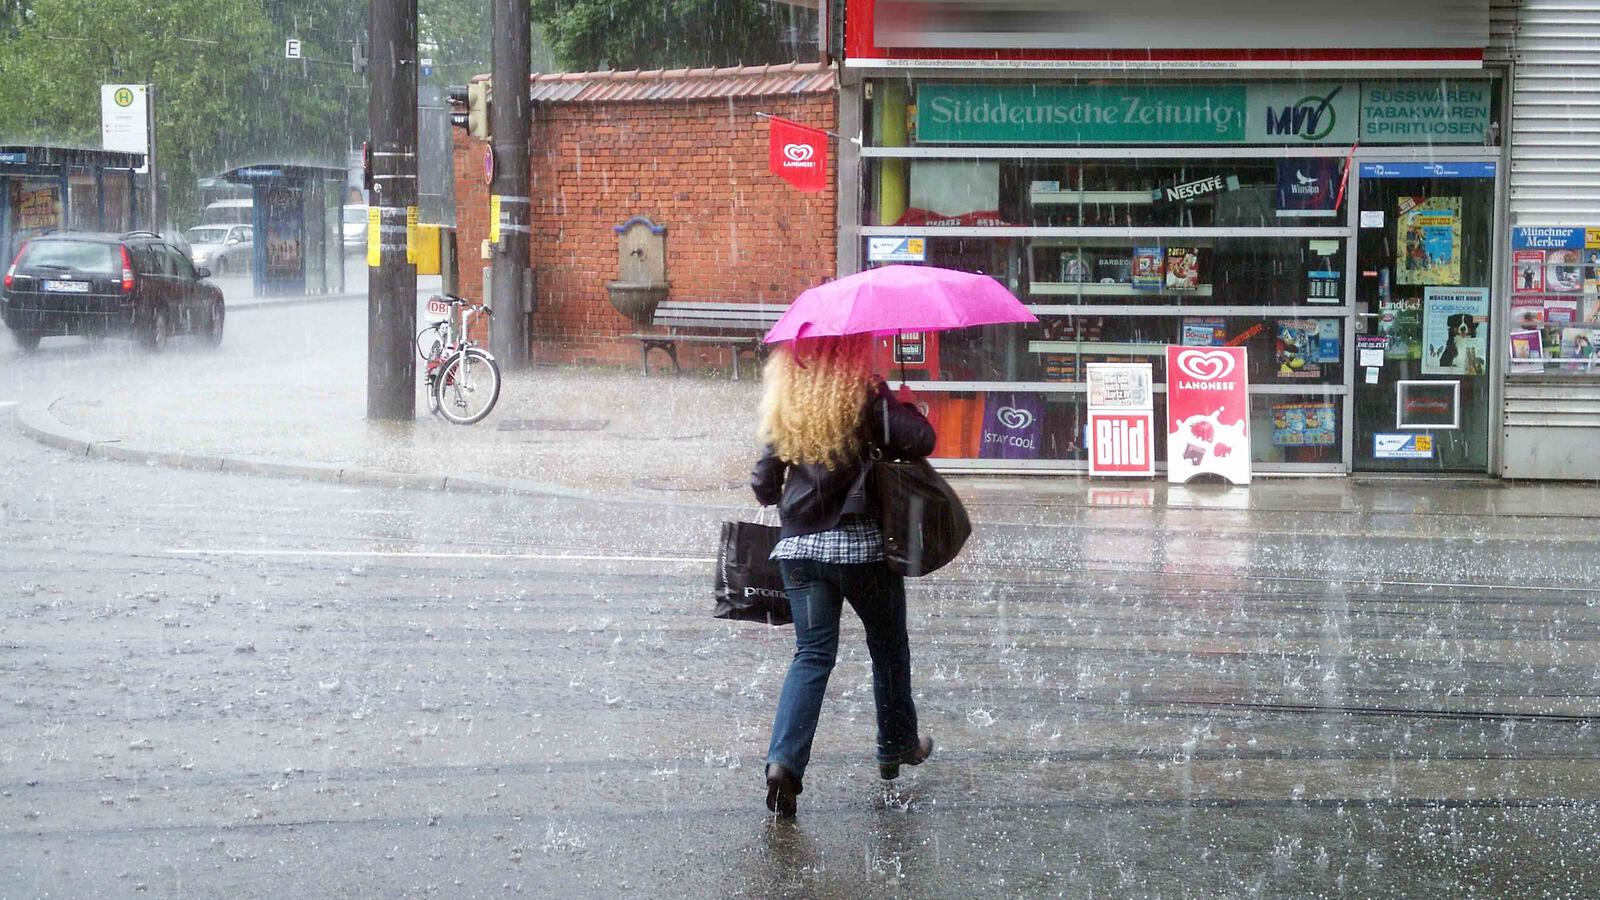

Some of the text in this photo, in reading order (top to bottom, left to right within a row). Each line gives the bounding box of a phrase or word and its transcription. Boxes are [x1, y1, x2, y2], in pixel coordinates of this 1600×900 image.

[289, 41, 298, 56] E
[1126, 61, 1160, 69] Umgebung
[120, 91, 128, 103] H
[931, 96, 1234, 133] Süddeutsche Zeitung
[1364, 106, 1488, 118] TABAKWAREN
[1366, 122, 1484, 135] SPIRITUOSEN
[1166, 175, 1223, 202] NESCAFÉ
[1291, 184, 1319, 194] Winston
[1520, 227, 1573, 237] Münchner
[1526, 237, 1568, 247] Merkur
[431, 302, 446, 313] DB
[1178, 381, 1234, 390] LANGNESE
[986, 432, 1035, 449] STAY COOL
[1096, 419, 1146, 466] Bild
